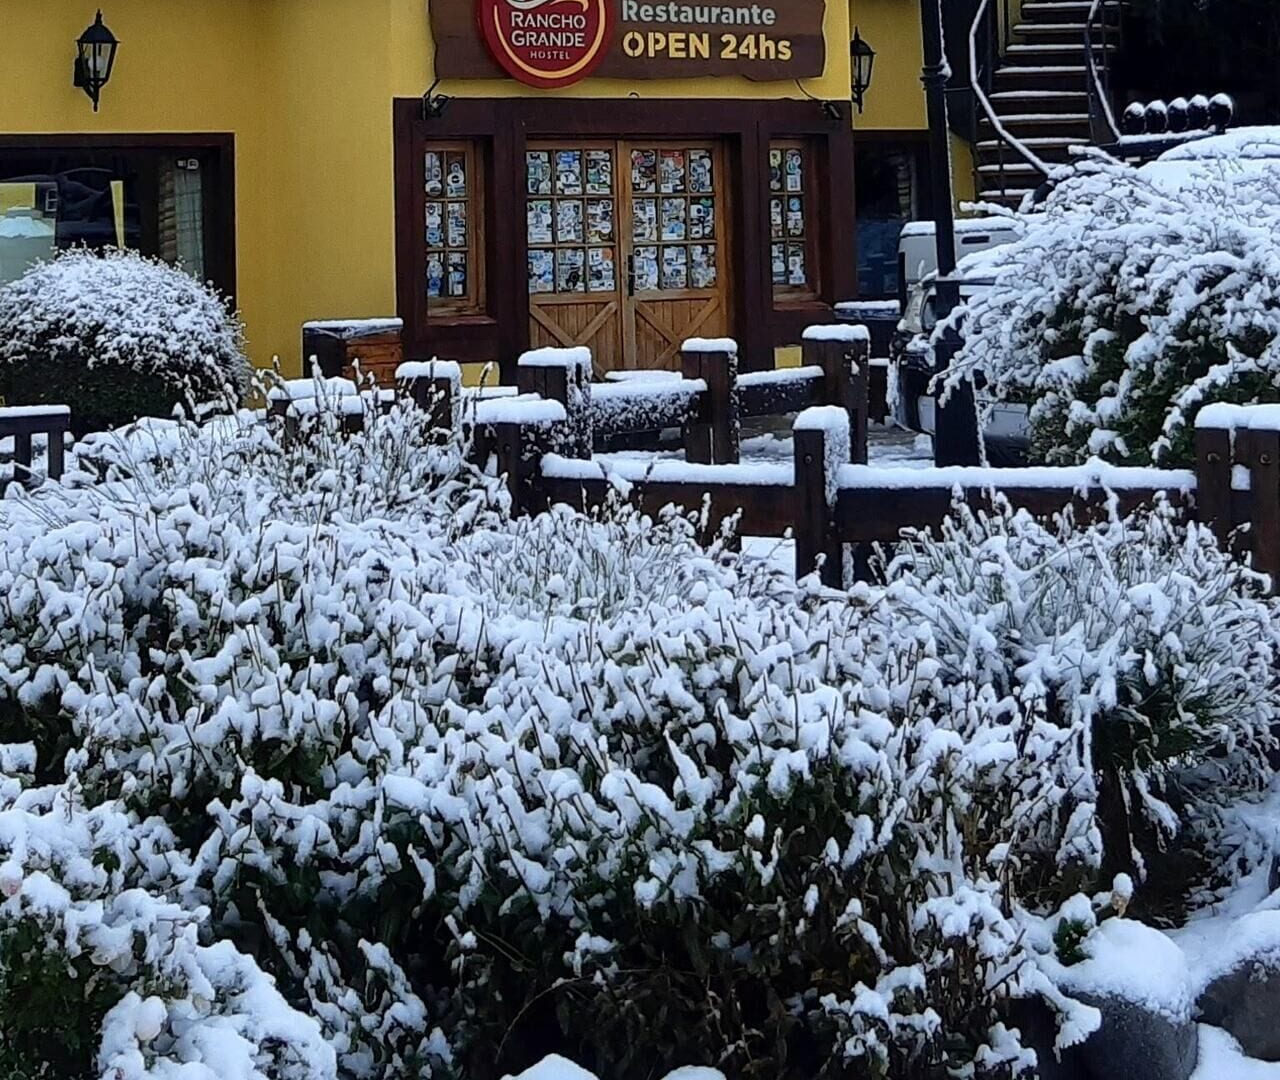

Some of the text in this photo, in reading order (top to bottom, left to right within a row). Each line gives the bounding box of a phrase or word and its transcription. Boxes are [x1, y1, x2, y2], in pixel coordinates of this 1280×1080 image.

[511, 11, 586, 28] RANCHO
[622, 0, 776, 25] Restaurante
[511, 30, 585, 47] GRANDE
[623, 31, 792, 61] OPEN 24hs
[530, 50, 570, 59] HOSTEL
